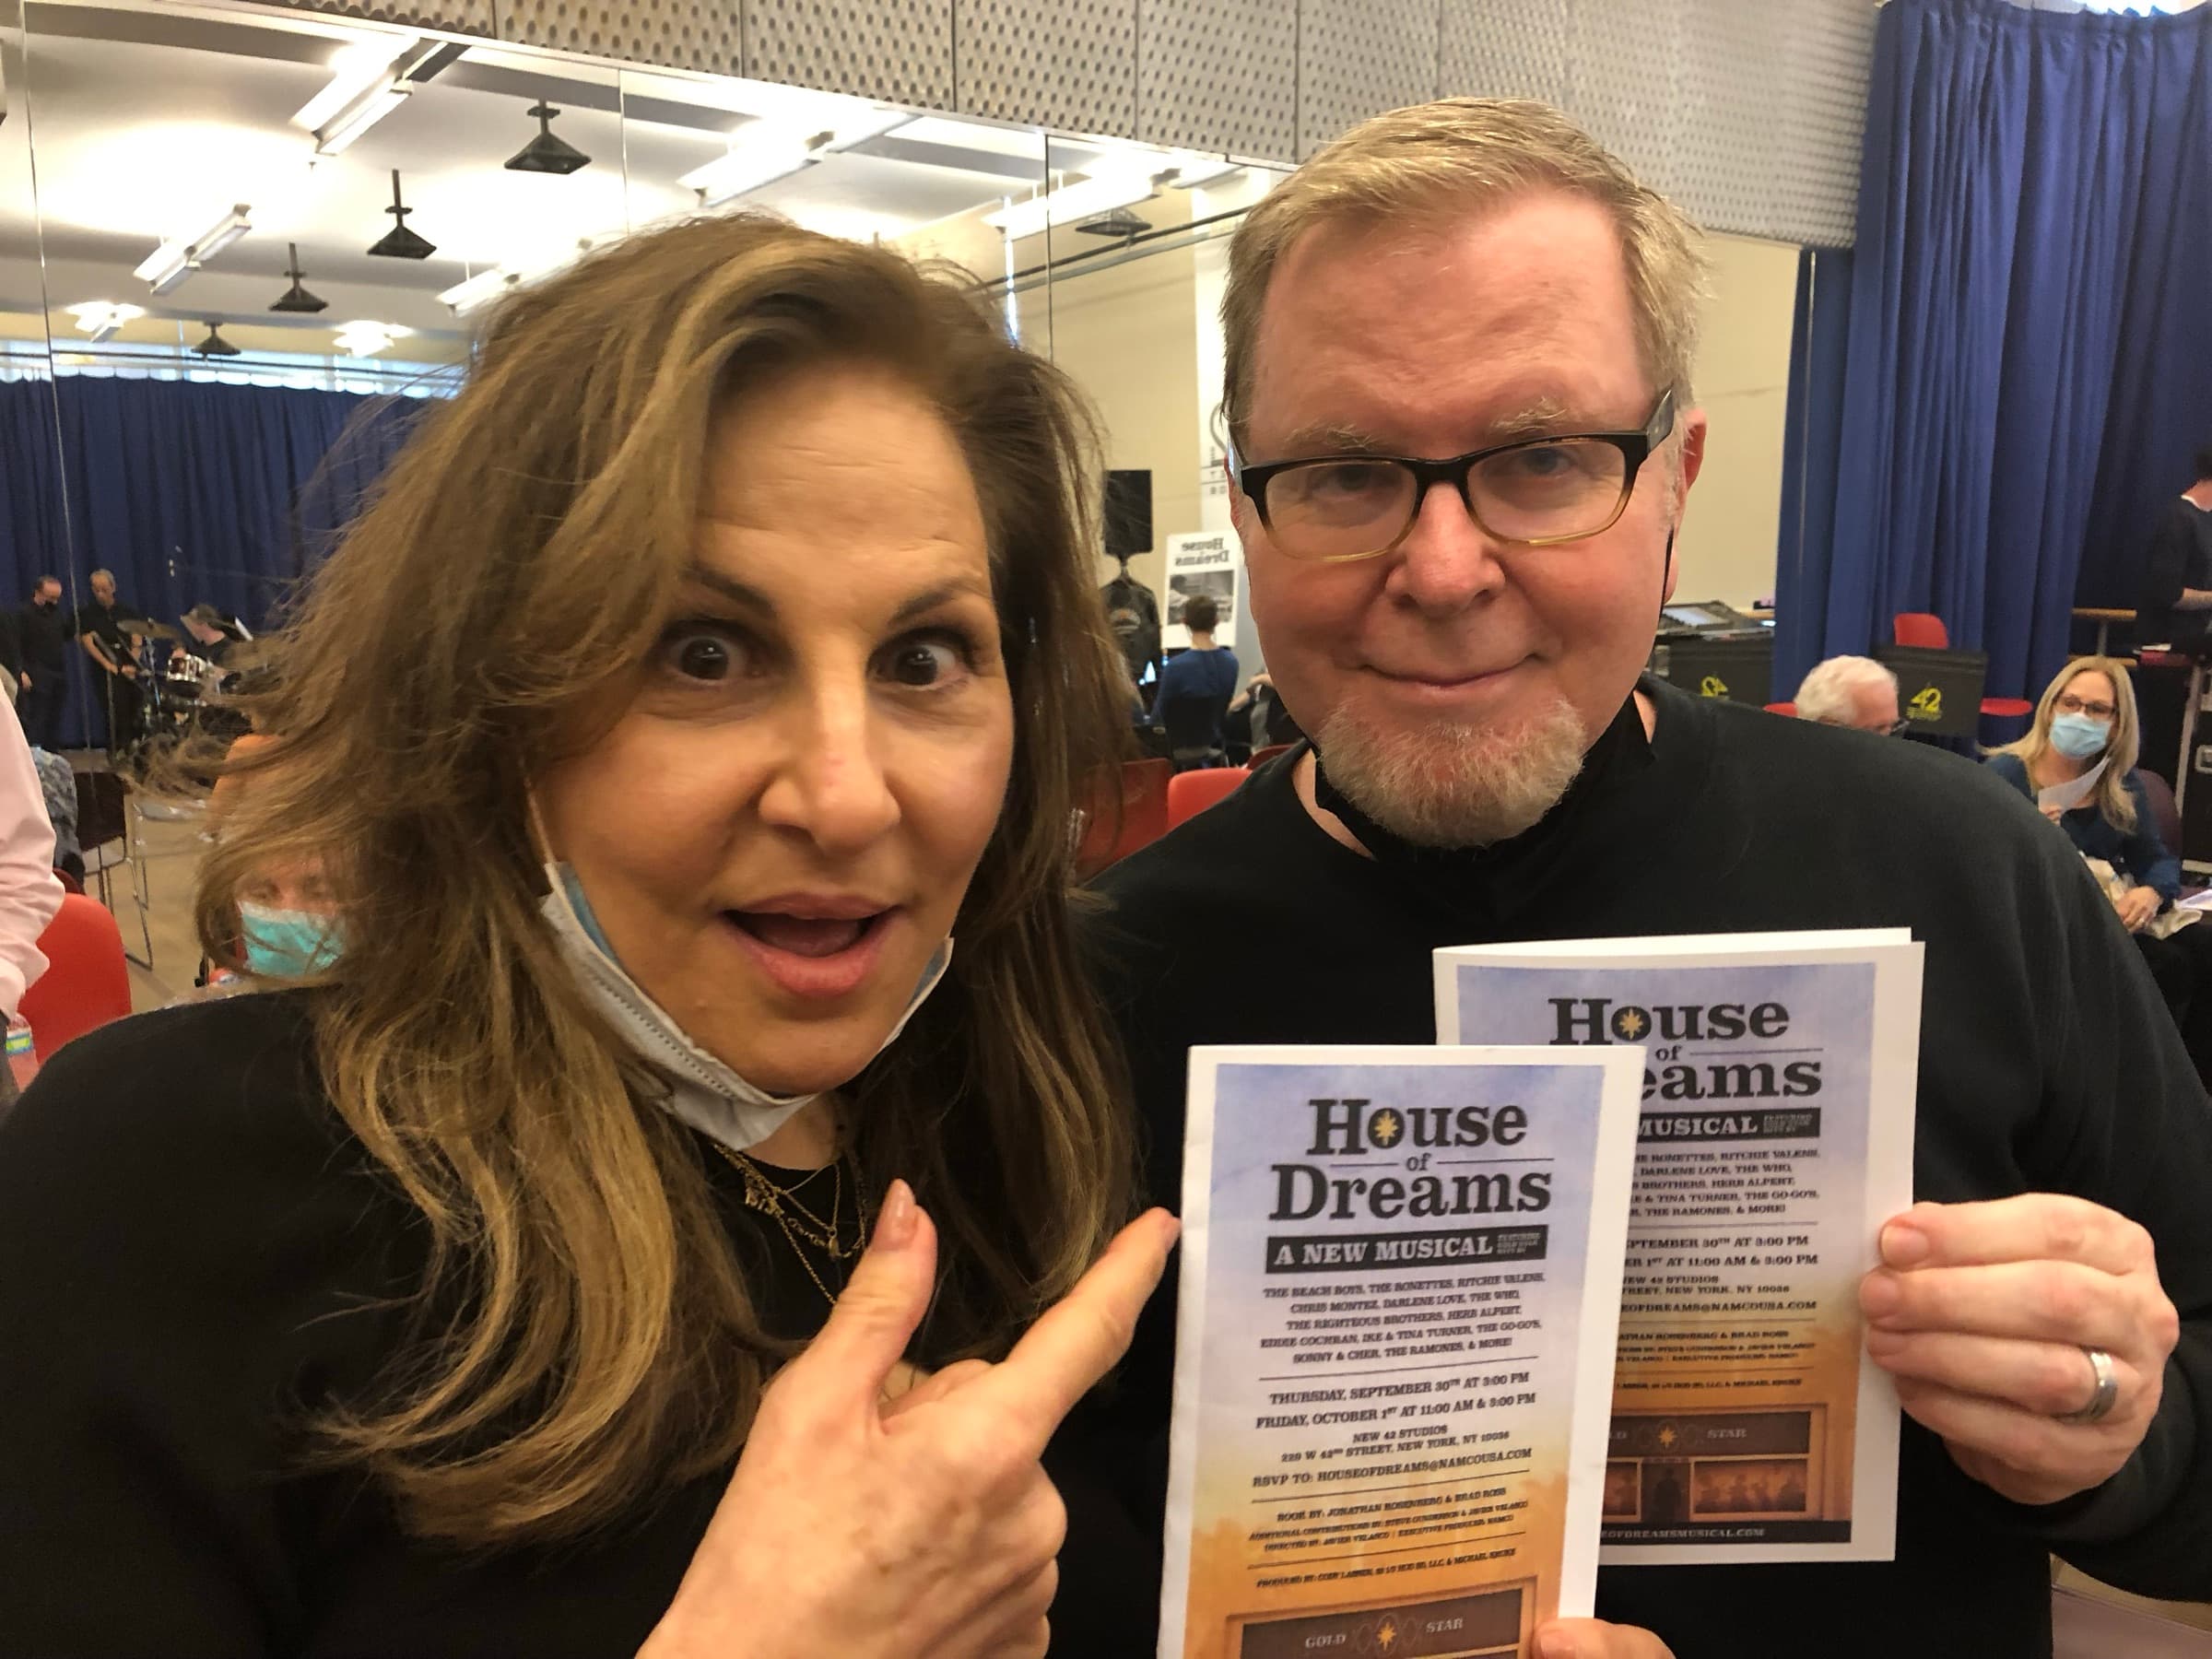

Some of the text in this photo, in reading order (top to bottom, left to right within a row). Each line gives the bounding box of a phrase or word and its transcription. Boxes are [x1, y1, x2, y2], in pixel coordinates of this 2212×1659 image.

[1911, 688, 1941, 712] 42
[1547, 997, 1790, 1045] House
[1655, 1044, 1684, 1061] of
[1639, 1060, 1823, 1100] eams
[1306, 1099, 1527, 1156] House
[1406, 1152, 1431, 1171] of
[1735, 1164, 1759, 1173] THE
[1268, 1164, 1552, 1222] Dreams
[1745, 1191, 1770, 1200] THE
[1645, 1207, 1670, 1217] THE
[1274, 1236, 1494, 1265] A NEW MUSICAL
[1734, 1237, 1752, 1248] AT
[1787, 1235, 1809, 1246] PM
[1665, 1256, 1685, 1267] AT
[1724, 1255, 1747, 1266] AM
[1795, 1253, 1819, 1265] PM
[1264, 1288, 1288, 1298] THE
[1291, 1287, 1332, 1297] BEACH
[1369, 1283, 1393, 1293] THE
[1290, 1302, 1327, 1313] CHRIS
[1469, 1291, 1491, 1302] THE
[1286, 1320, 1312, 1331] THE
[1448, 1309, 1477, 1320] HERB
[1362, 1332, 1383, 1343] IKE
[1384, 1332, 1394, 1340] &
[1396, 1329, 1423, 1339] TINA
[1477, 1323, 1499, 1333] THE
[1335, 1351, 1345, 1361] &
[1384, 1347, 1407, 1357] THE
[1468, 1341, 1477, 1350] &
[1269, 1389, 1347, 1405] THURSDAY,
[1349, 1382, 1431, 1400] SEPTEMBER
[1464, 1377, 1480, 1389] AT
[1482, 1375, 1508, 1387] 3:00
[1510, 1371, 1530, 1383] PM
[1255, 1415, 1310, 1429] FRIDAY,
[1312, 1409, 1378, 1425] OCTOBER
[1400, 1406, 1417, 1418] AT
[1419, 1403, 1450, 1416] 11:00
[1453, 1399, 1474, 1413] AM
[1477, 1398, 1486, 1409] &
[1516, 1393, 1536, 1405] PM
[1352, 1425, 1448, 1443] NEW 42 STUDIOS
[1305, 1451, 1317, 1461] W
[1396, 1440, 1424, 1453] NEW
[1463, 1433, 1478, 1443] NY
[1253, 1475, 1289, 1488] RSVP
[1292, 1473, 1313, 1485] TO:
[1444, 1495, 1453, 1503] &
[1304, 1617, 1464, 1650] GOLD STAR
